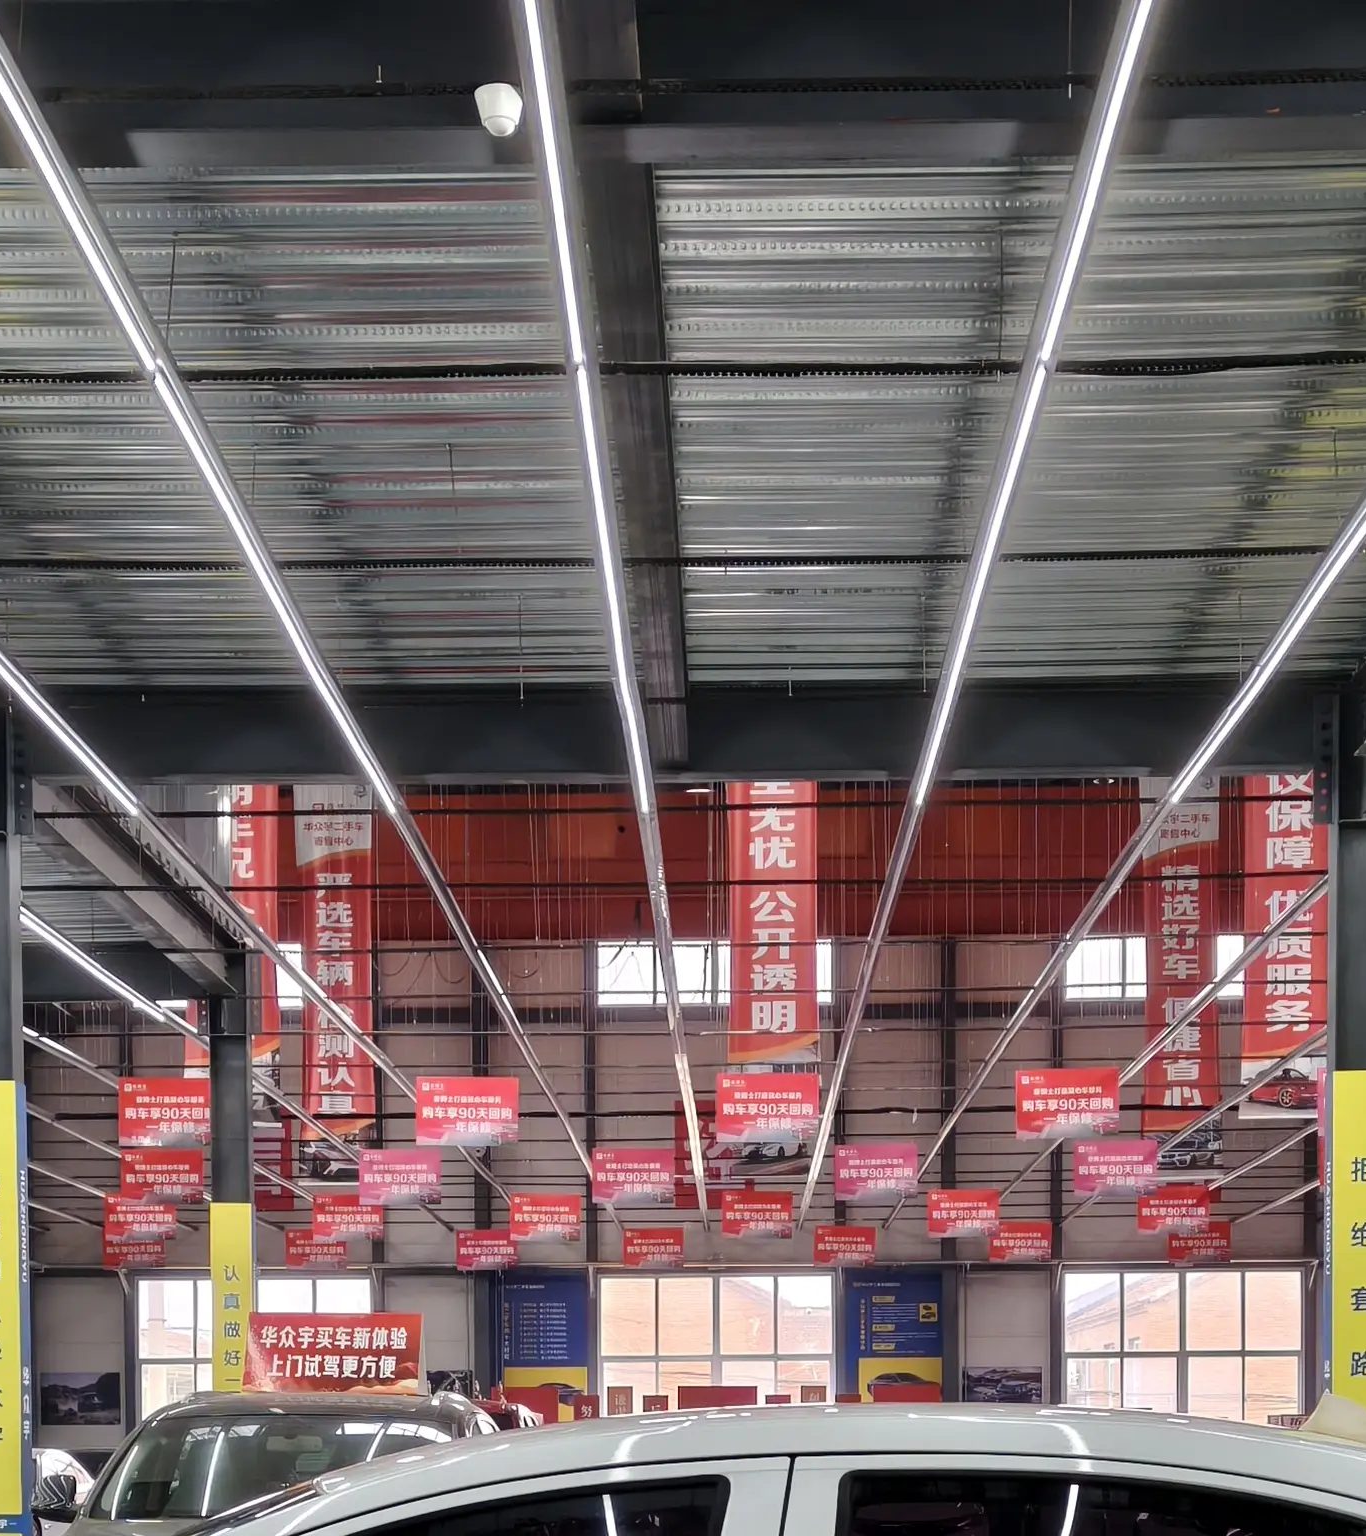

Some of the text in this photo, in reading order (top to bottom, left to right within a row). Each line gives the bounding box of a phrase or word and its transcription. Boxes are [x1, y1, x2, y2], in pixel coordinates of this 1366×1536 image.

[750, 891, 797, 1033] 公开透明
[1265, 890, 1313, 1033] 优质服务
[1162, 865, 1202, 1106] 精选好车 便捷省心
[316, 873, 357, 1115] 严选车辆 检测认真
[723, 1103, 814, 1115] 购车享90天回购
[1022, 1097, 1114, 1112] 购车享90天回购
[422, 1107, 513, 1119] 购车享90天回购
[146, 1121, 195, 1134] 一年保修
[839, 1168, 913, 1178] 购车享90天回购
[1078, 1164, 1153, 1175] 购车享90天回购
[125, 1173, 199, 1184] 购车享90天回购
[364, 1173, 437, 1183] 购车享90天回购
[597, 1172, 670, 1182] 购车享90天回购
[223, 1265, 241, 1382] 认真做好一
[260, 1325, 408, 1350] 华众宇买车新体验
[266, 1355, 397, 1379] 上门试驾更方便
